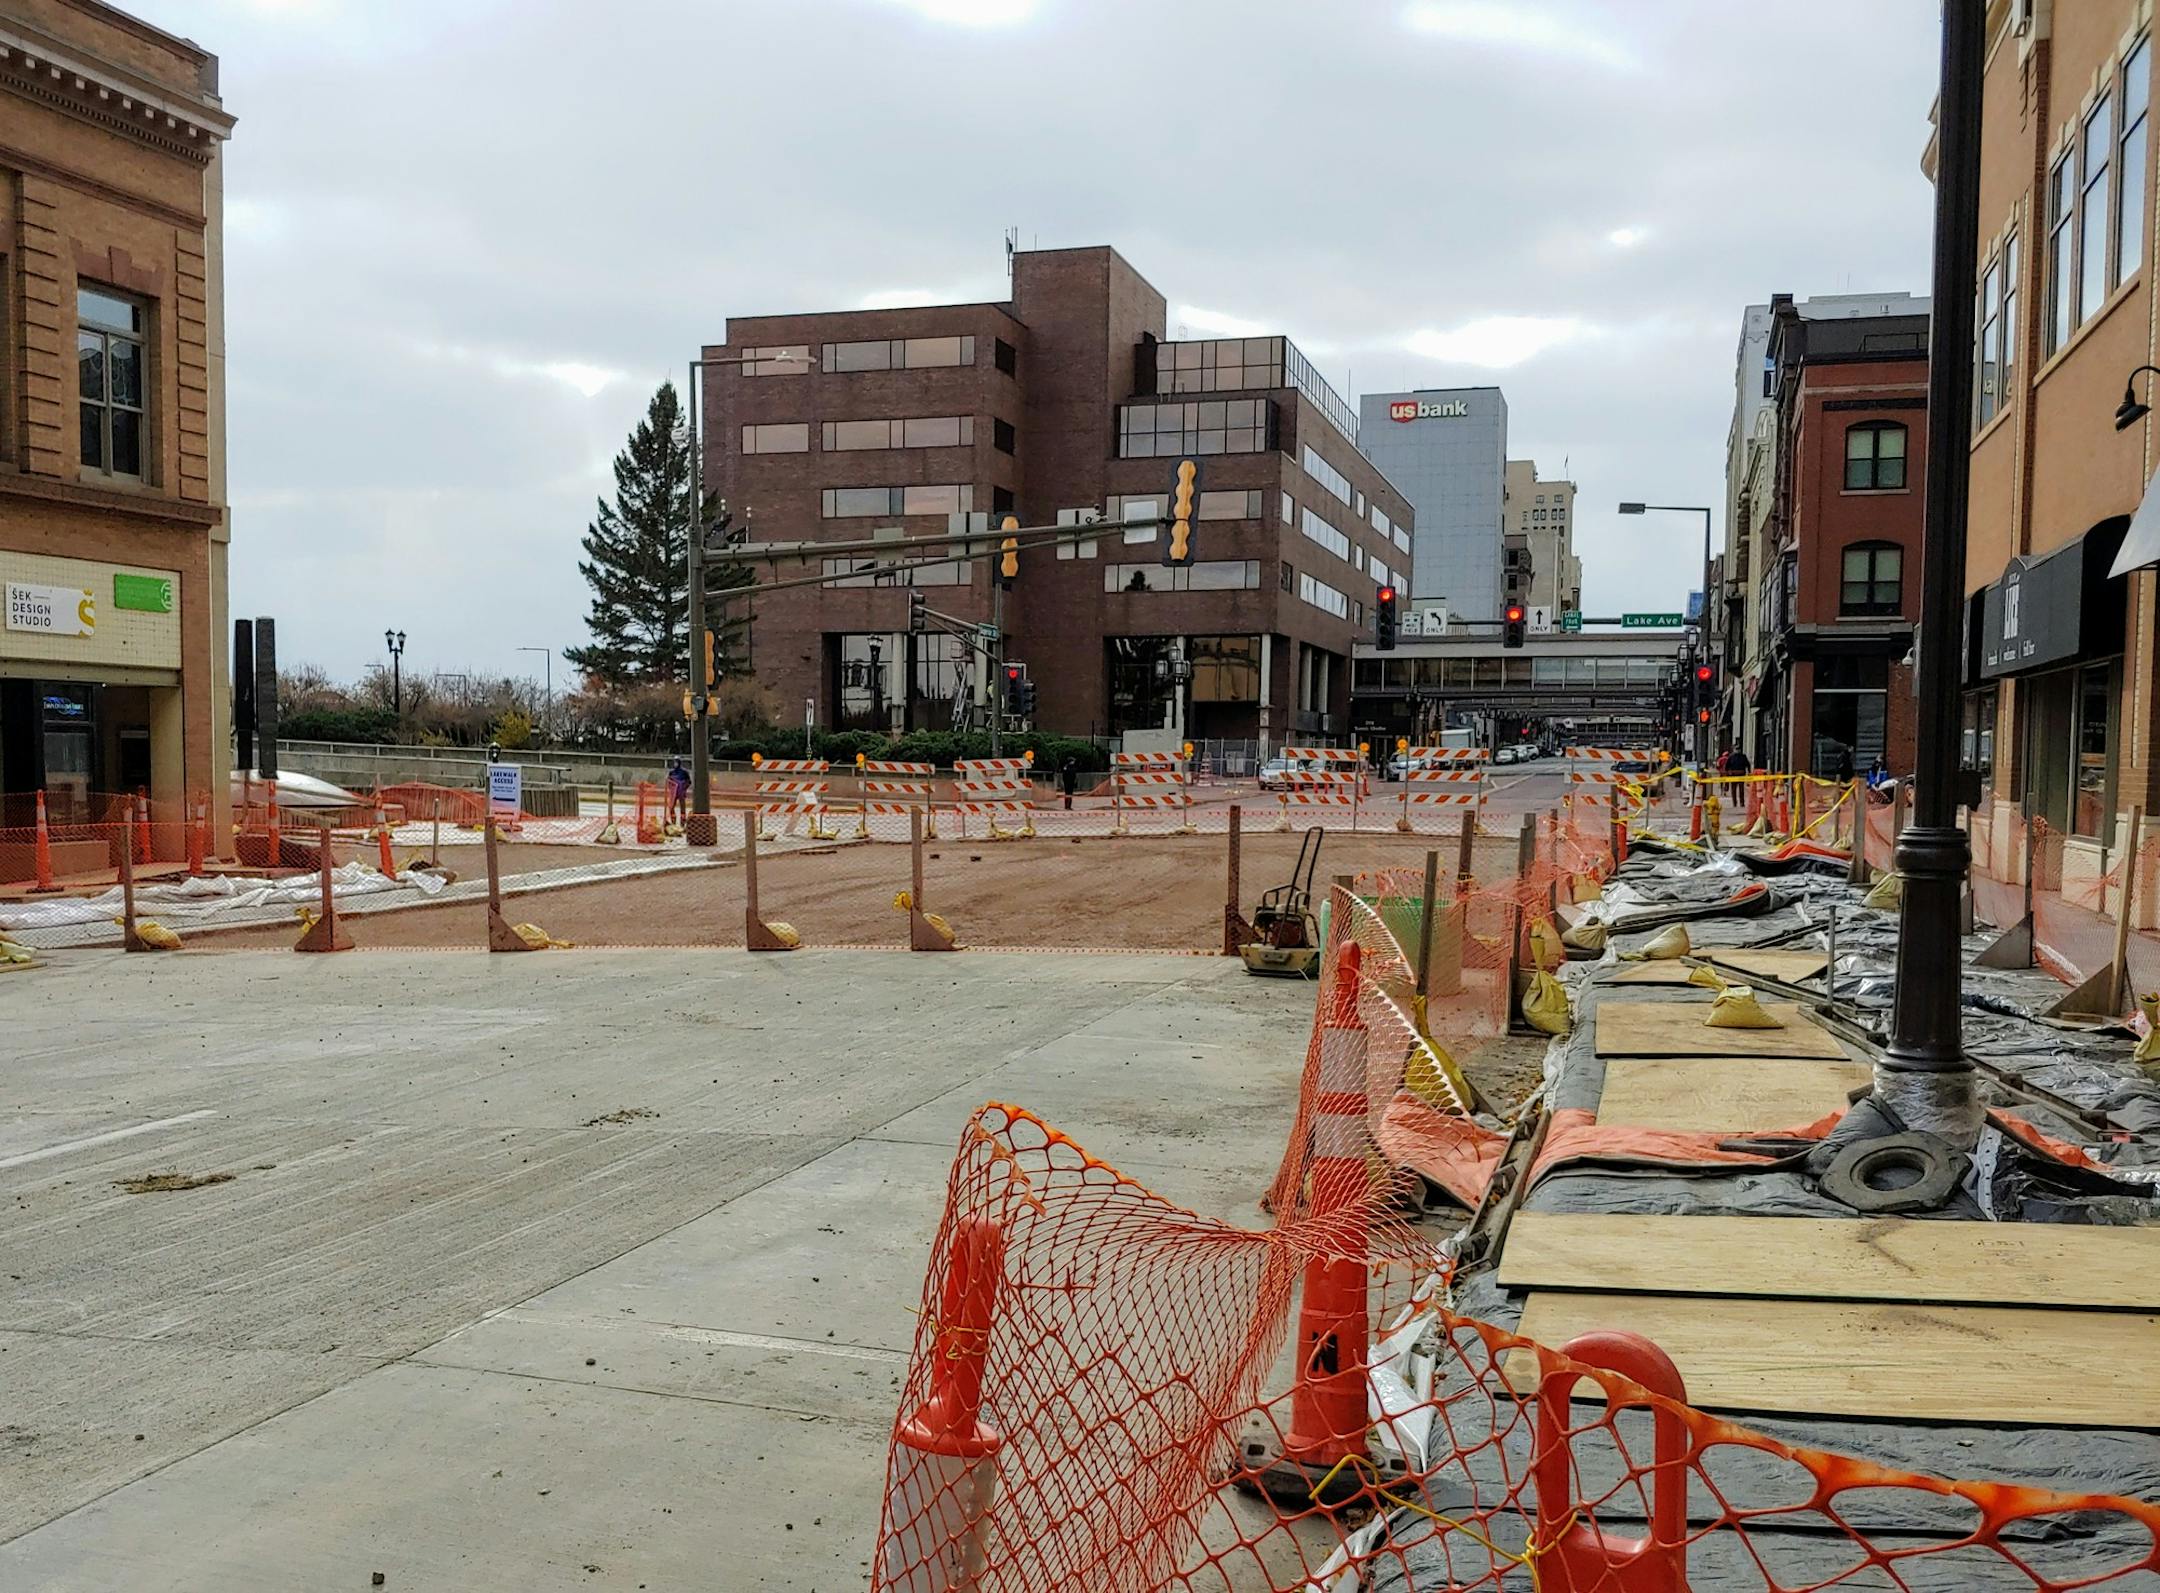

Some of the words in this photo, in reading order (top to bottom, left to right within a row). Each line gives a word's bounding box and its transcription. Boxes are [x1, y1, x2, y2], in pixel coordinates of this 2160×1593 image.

[12, 602, 51, 615] DESIGN
[12, 615, 51, 627] STUDIO
[1626, 616, 1652, 625] Lake
[1657, 616, 1678, 625] Ave
